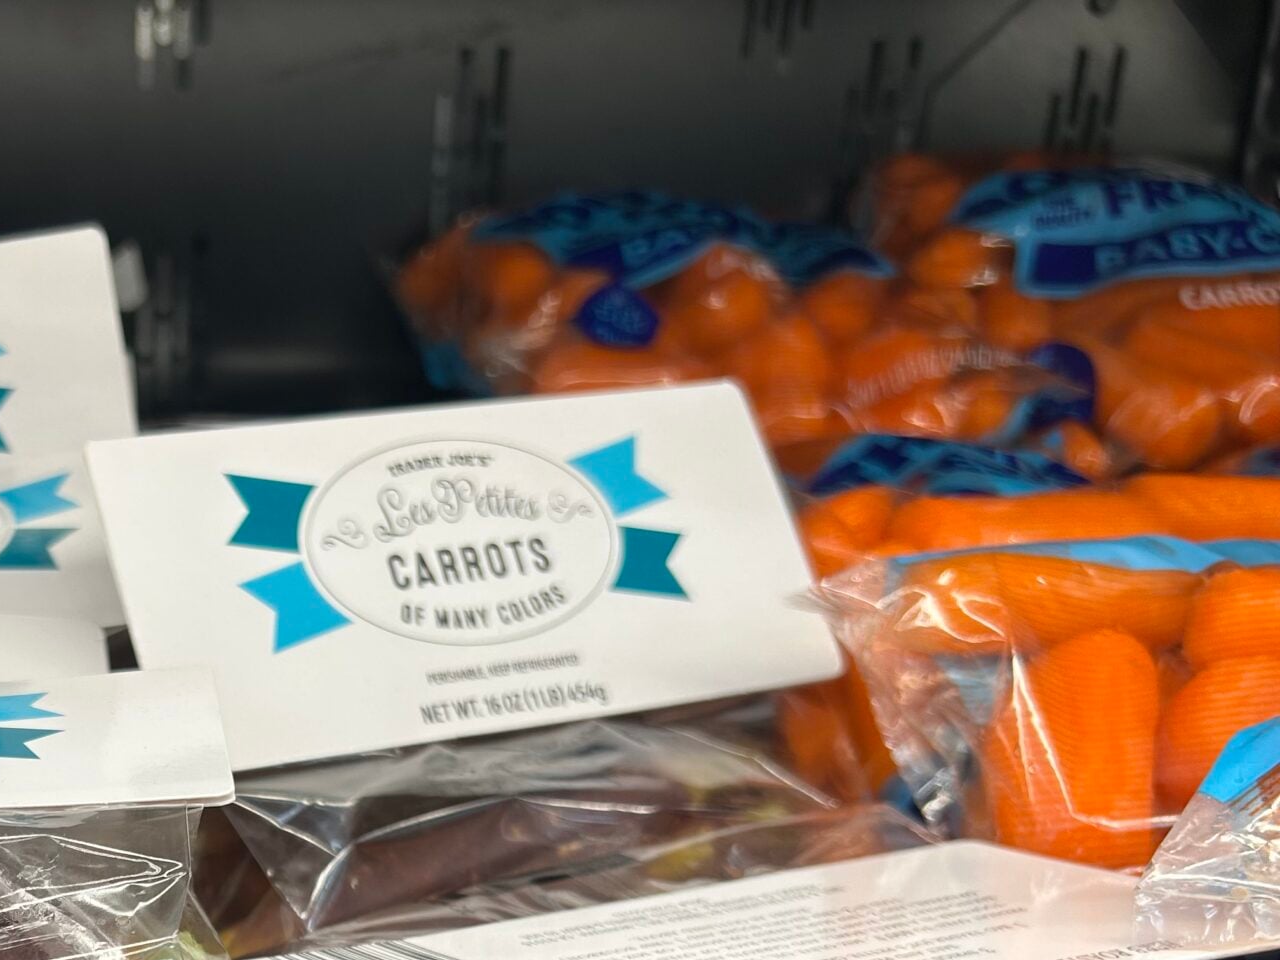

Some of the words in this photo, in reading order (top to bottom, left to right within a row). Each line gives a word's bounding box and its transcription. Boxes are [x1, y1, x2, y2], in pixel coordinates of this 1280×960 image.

[387, 455, 442, 477] TRADER
[448, 453, 491, 468] JOE'S
[374, 483, 436, 542] Les
[431, 475, 543, 523] Petites
[387, 537, 553, 591] CARROTS
[400, 602, 426, 625] OF
[434, 607, 490, 630] MANY
[497, 585, 566, 625] COLORS
[419, 702, 451, 725] NET
[451, 698, 484, 720] WT.
[486, 696, 502, 716] 16
[502, 693, 524, 714] OZ
